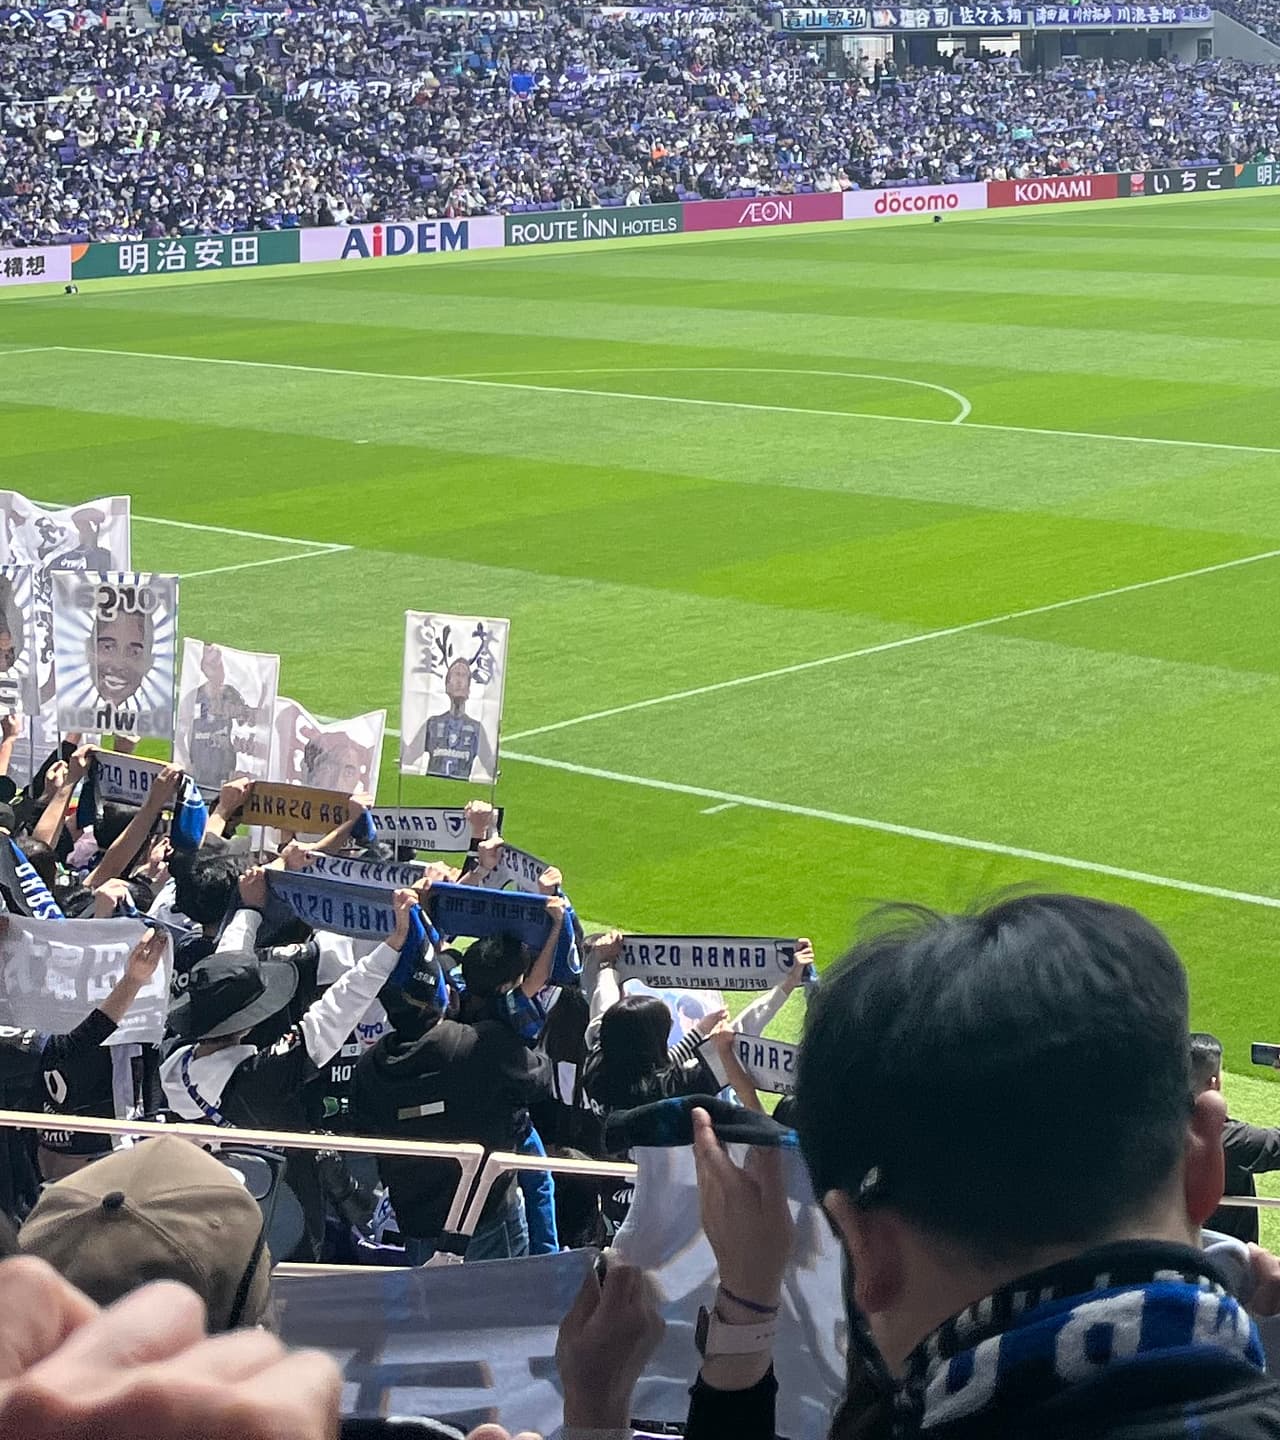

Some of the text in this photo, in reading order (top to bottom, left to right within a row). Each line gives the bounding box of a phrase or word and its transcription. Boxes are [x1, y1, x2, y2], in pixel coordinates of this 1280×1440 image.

[785, 9, 866, 29] 青山敏弘
[960, 6, 1022, 24] 佐々木翔
[1014, 179, 1092, 202] KONAMI
[1152, 167, 1224, 194] いちご
[874, 192, 959, 215] docomo
[511, 221, 578, 244] ROUTE
[622, 217, 678, 234] HOTELS
[118, 237, 259, 274] 明治安田
